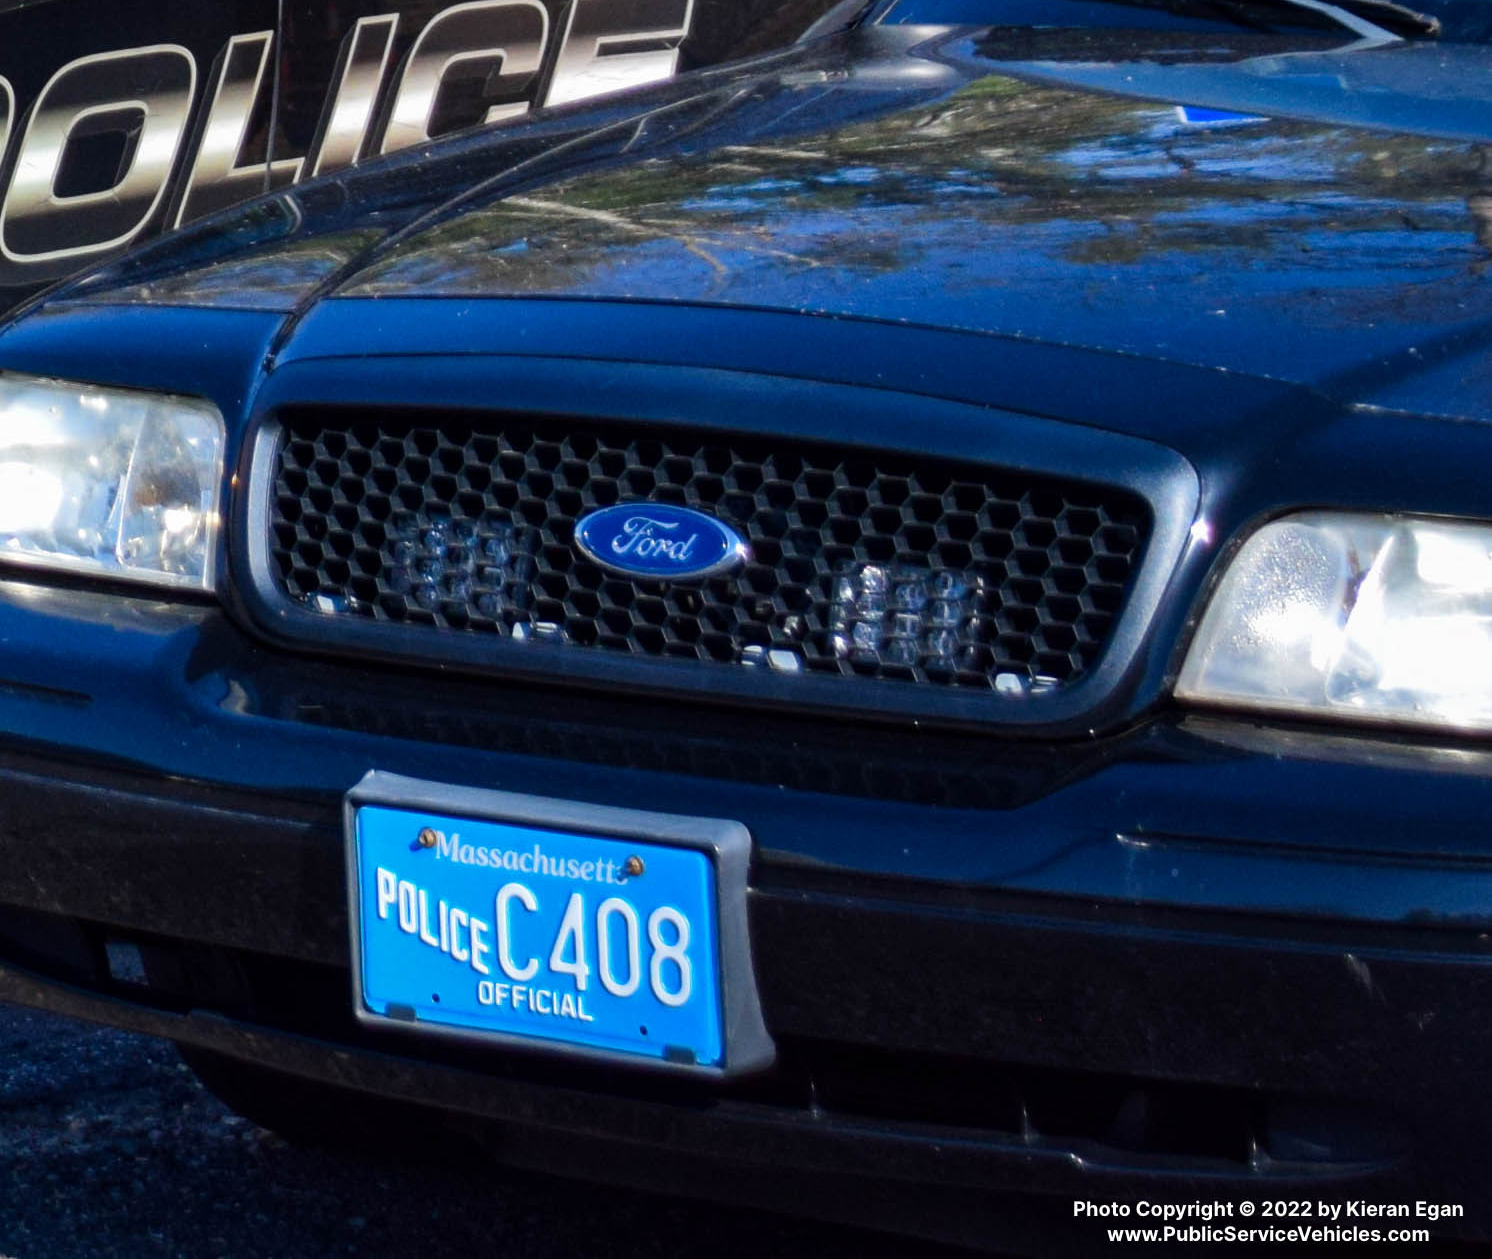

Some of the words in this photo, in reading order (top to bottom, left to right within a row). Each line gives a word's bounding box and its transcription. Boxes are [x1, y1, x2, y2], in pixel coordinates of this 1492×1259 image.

[612, 516, 698, 560] Ford
[377, 867, 490, 975] POLICE
[496, 882, 692, 1007] C408
[478, 981, 594, 1022] OFFICIAL
